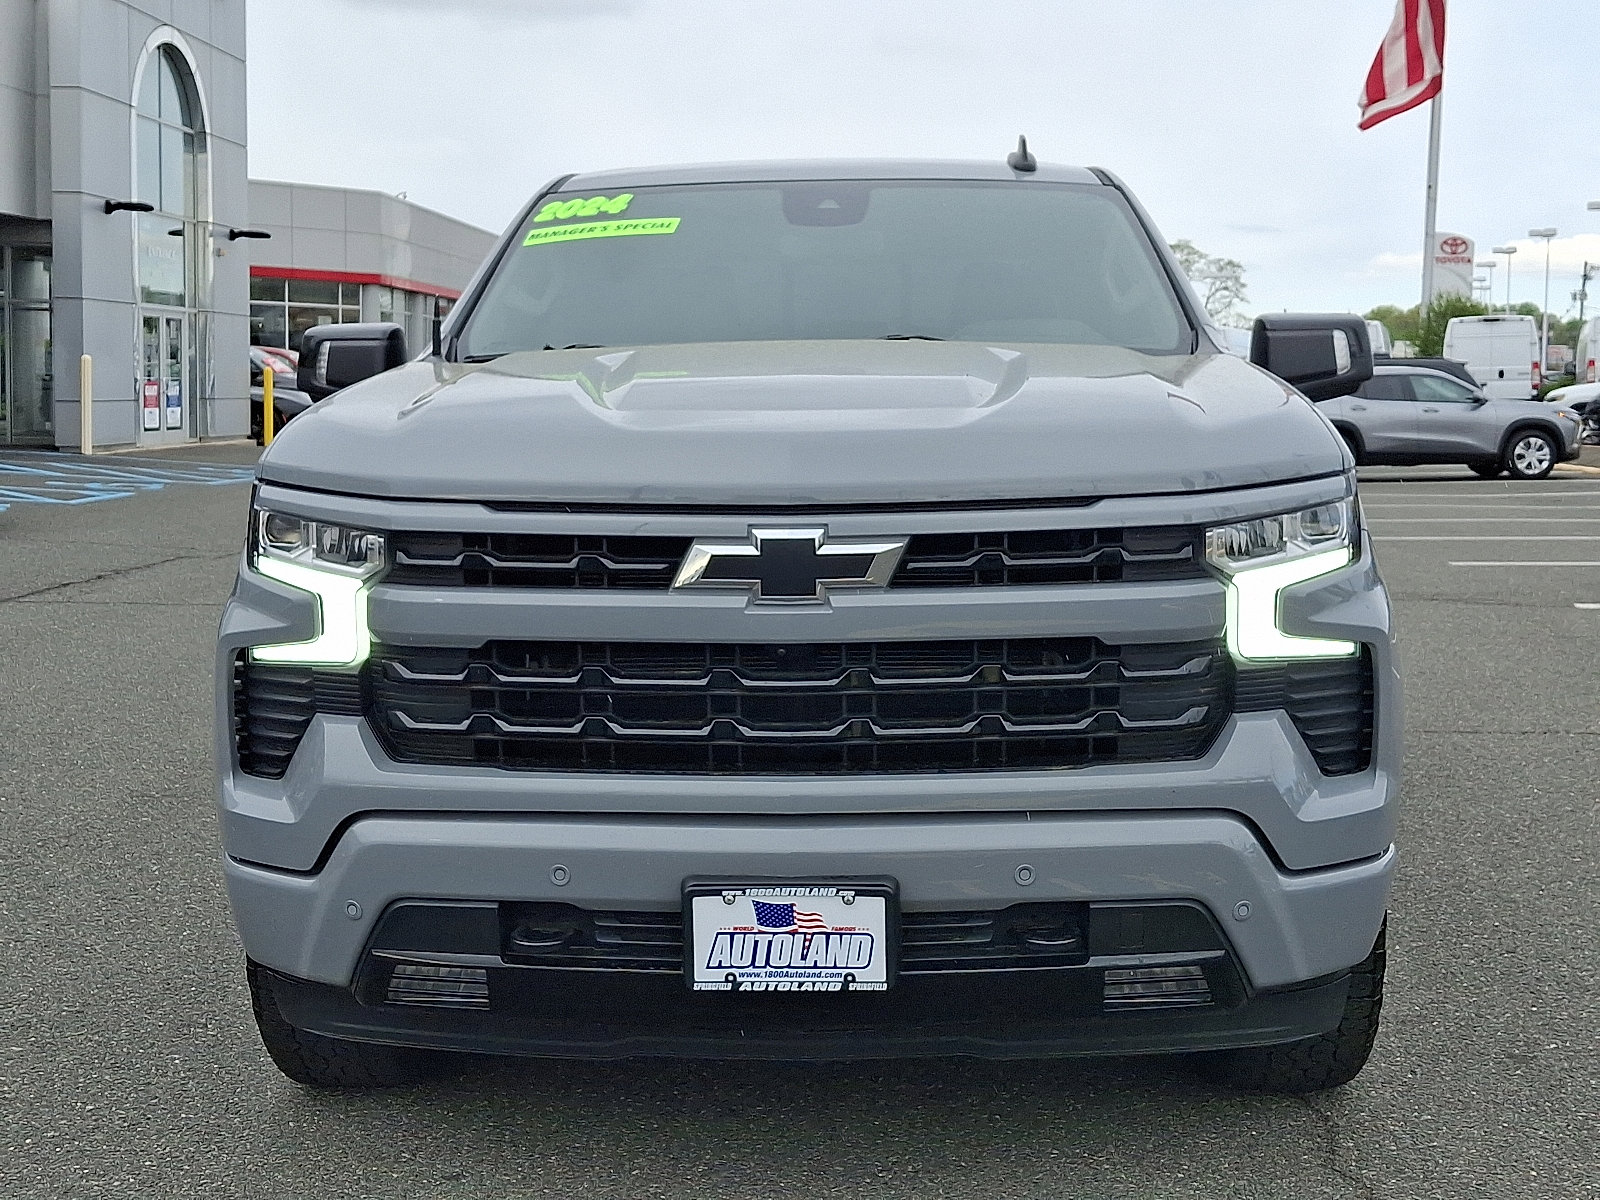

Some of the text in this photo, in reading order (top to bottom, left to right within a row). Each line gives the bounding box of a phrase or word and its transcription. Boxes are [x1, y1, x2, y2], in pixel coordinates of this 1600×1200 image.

[533, 193, 634, 222] 2024
[528, 222, 672, 240] MANAGER'S SPECIAL
[1435, 256, 1472, 264] TOYOTA
[707, 932, 872, 968] AUTOLAND
[738, 970, 843, 979] www.1800Autoland.com
[739, 982, 842, 991] AUTOLAND
[848, 983, 888, 991] SPRINGFIELD
